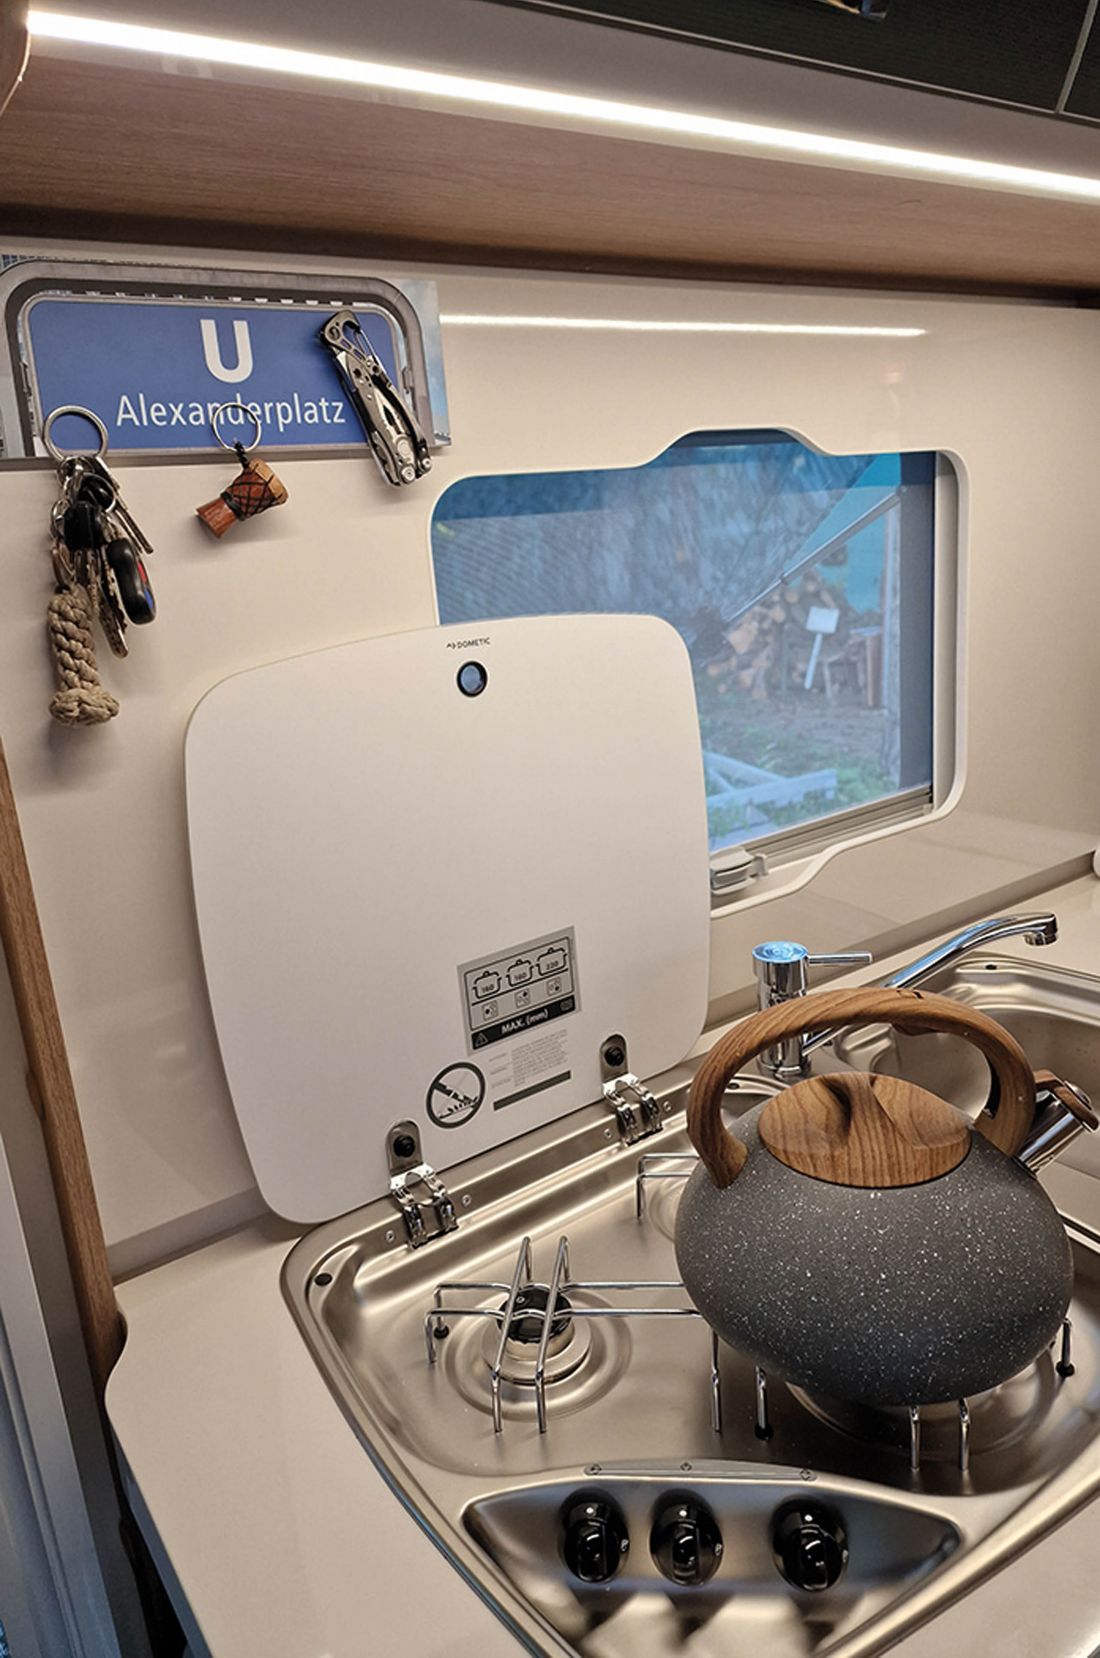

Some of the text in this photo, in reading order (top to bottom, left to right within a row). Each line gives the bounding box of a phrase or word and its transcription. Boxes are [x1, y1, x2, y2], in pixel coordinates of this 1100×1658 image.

[200, 319, 253, 384] U
[116, 392, 346, 432] Alexanderplatz
[457, 637, 490, 649] DOMETIC
[501, 1018, 525, 1034] MAX.
